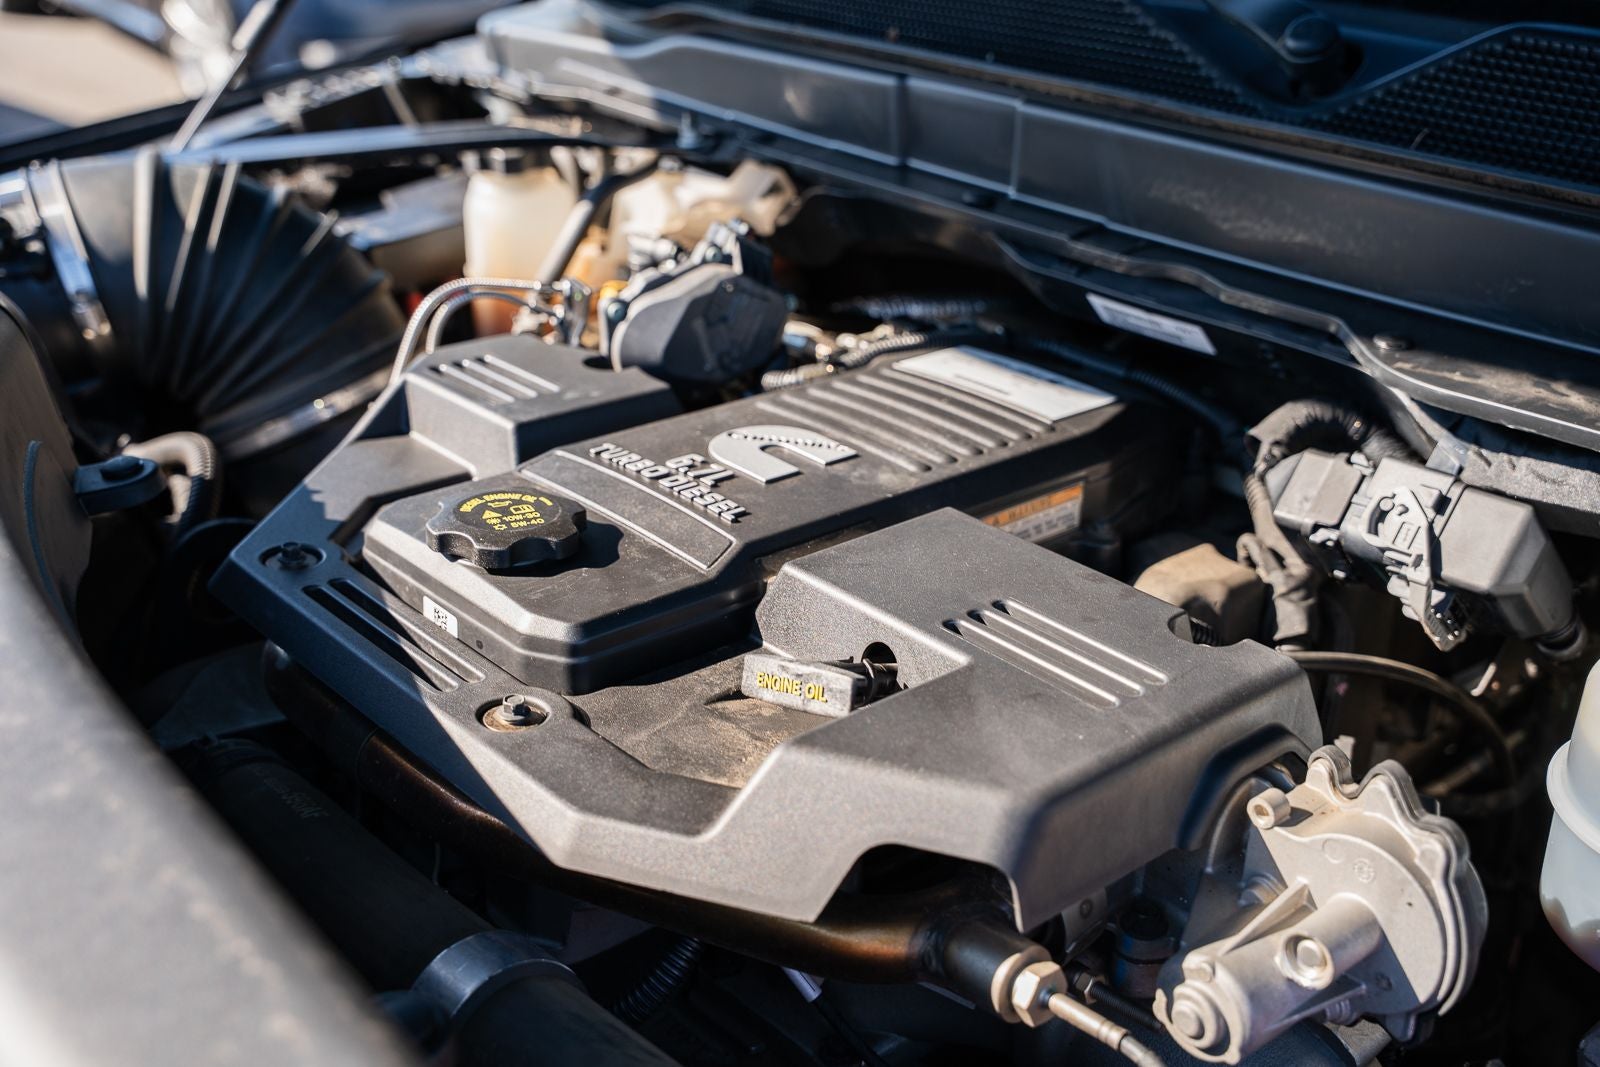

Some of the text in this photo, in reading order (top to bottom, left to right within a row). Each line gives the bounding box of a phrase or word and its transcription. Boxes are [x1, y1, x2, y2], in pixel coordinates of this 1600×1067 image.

[589, 442, 747, 523] TURBO DIESEL
[665, 453, 735, 487] 6.7L
[503, 512, 541, 522] 10W-30
[757, 671, 828, 703] ENGINE OIL
